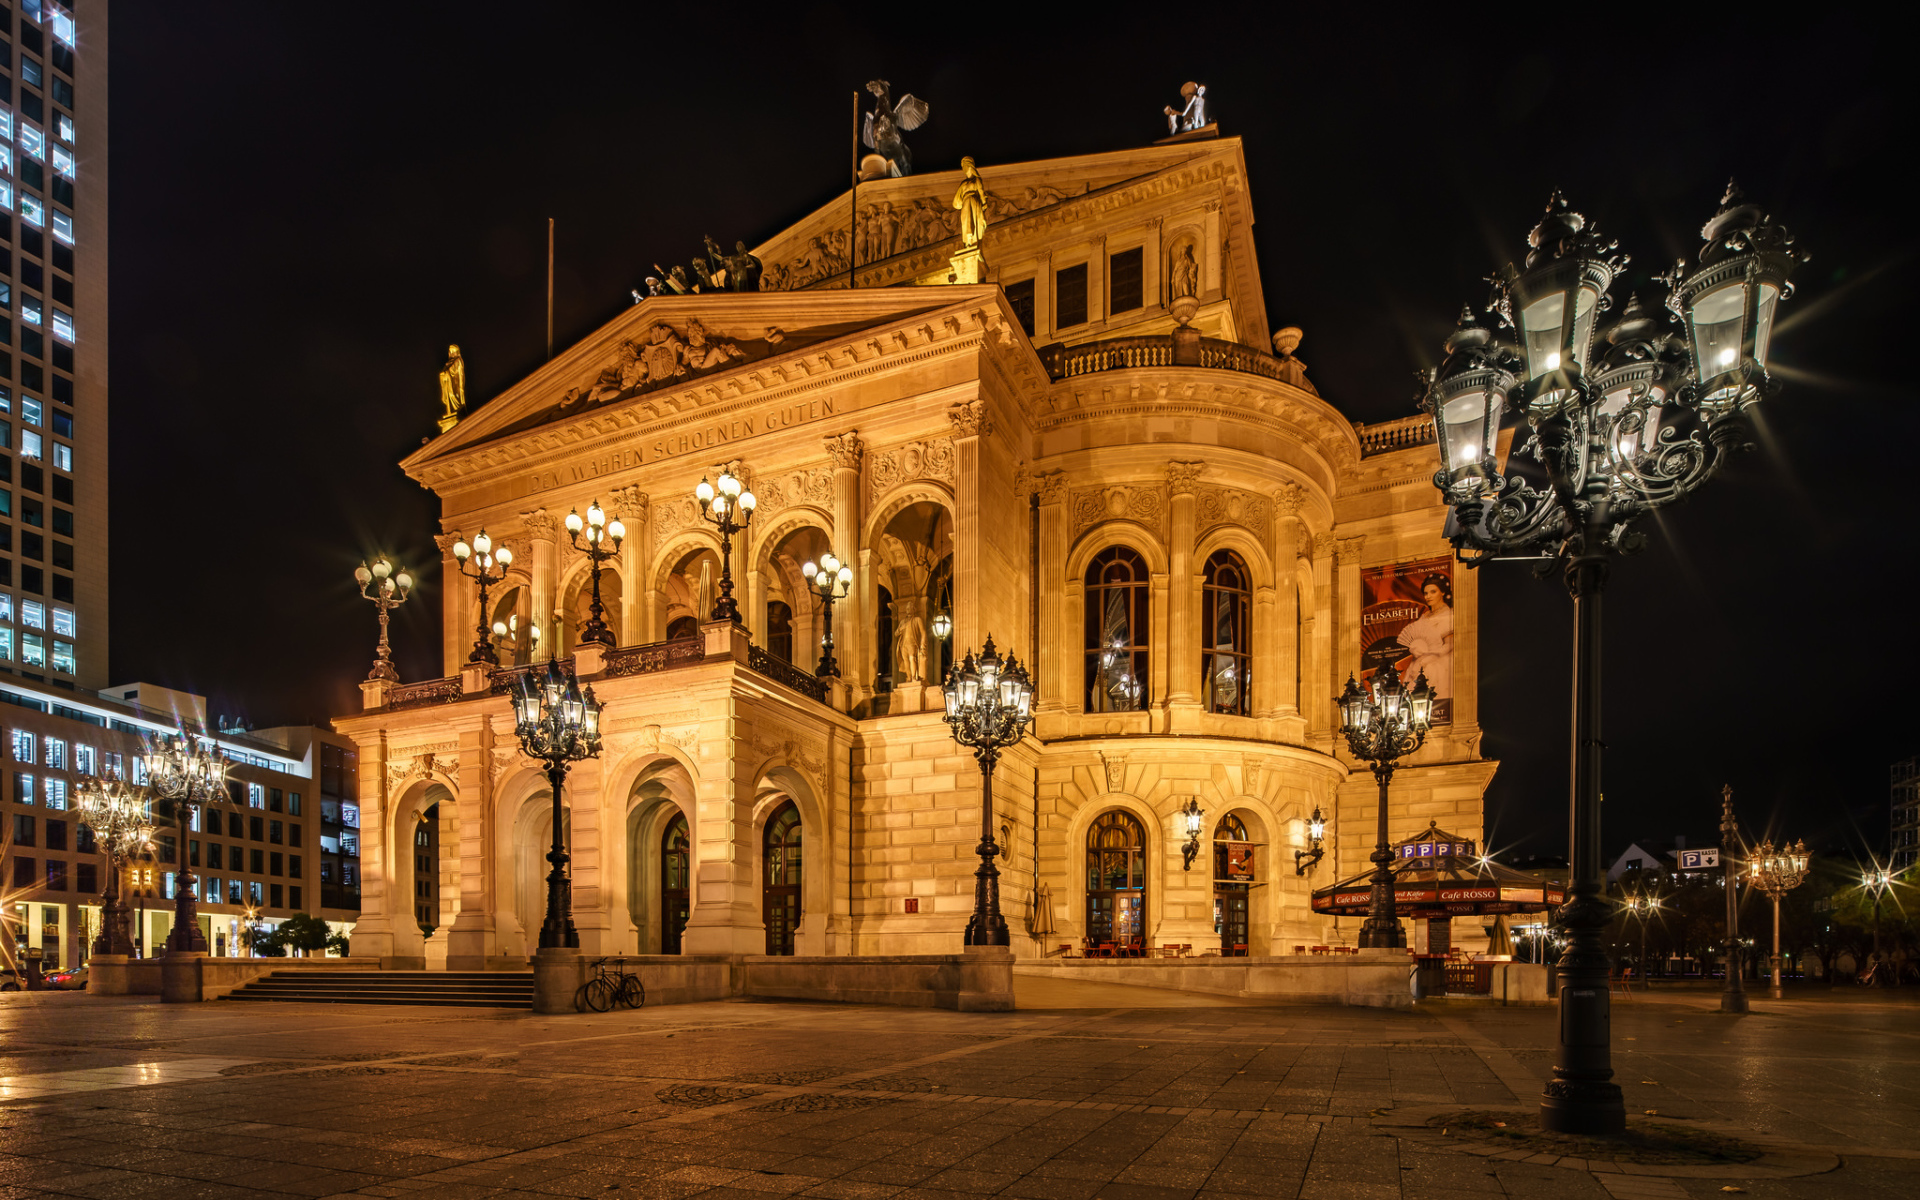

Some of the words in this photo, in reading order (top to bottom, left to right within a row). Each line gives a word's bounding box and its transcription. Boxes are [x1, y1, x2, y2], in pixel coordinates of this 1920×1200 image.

[531, 468, 564, 492] DEM
[570, 447, 645, 481] WAHREN
[653, 415, 754, 458] SCHOENEN
[1418, 564, 1449, 574] FRANKFURT
[1363, 607, 1419, 626] ELISABETH
[1351, 893, 1370, 902] ROSS
[1463, 890, 1496, 899] ROSSO
